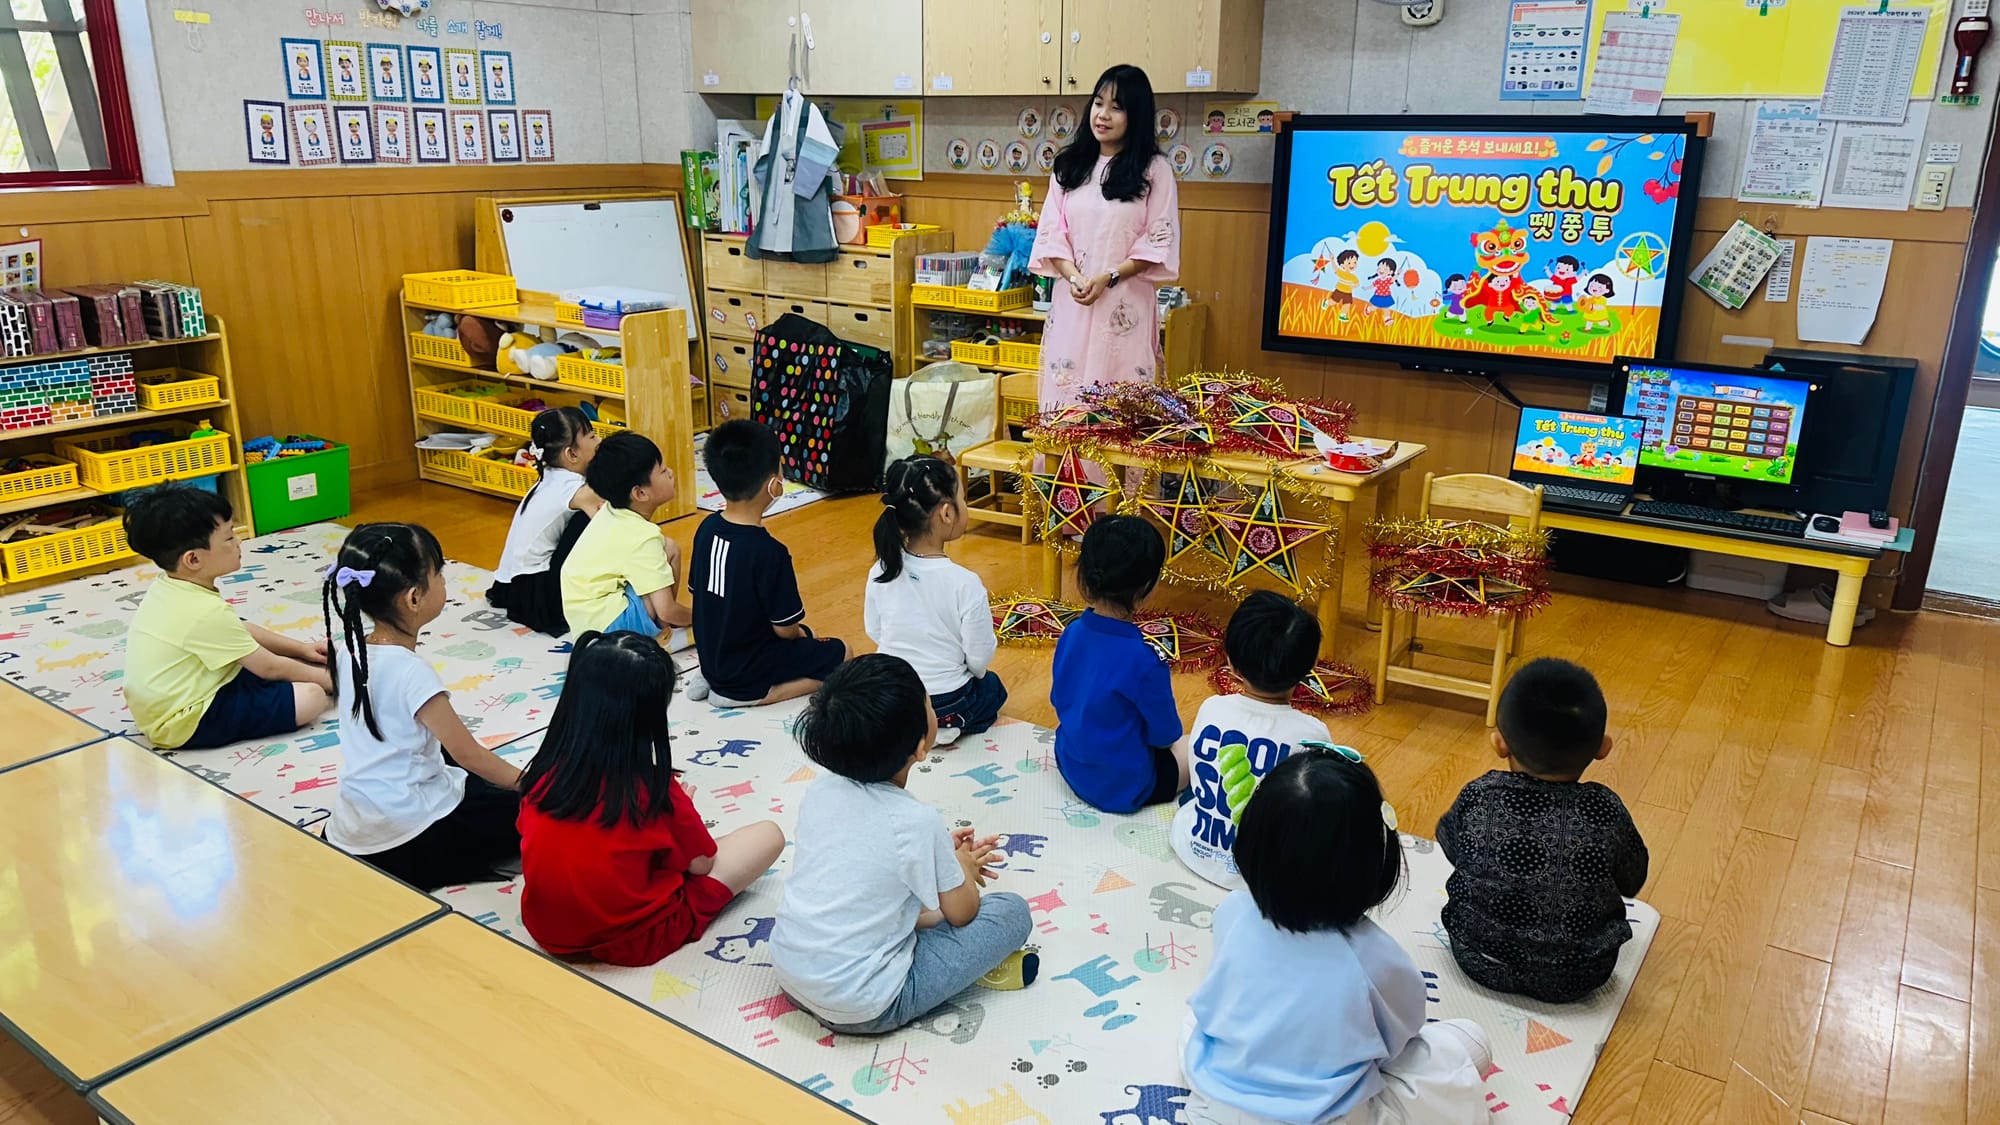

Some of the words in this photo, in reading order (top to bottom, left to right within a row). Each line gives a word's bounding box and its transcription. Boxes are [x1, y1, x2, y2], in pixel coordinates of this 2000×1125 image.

[401, 5, 410, 13] 30
[420, 0, 429, 8] 25
[304, 8, 344, 27] 만나서
[417, 16, 438, 37] 나를
[447, 20, 468, 33] 소개
[475, 20, 502, 40] 할게!
[1227, 117, 1255, 128] 도서관
[1419, 138, 1452, 155] 즐거운
[1456, 139, 1480, 155] 추석
[1483, 139, 1540, 155] 보내세요!
[1328, 160, 1397, 206] Tết
[1404, 163, 1530, 214] Trung
[1535, 165, 1623, 212] thu
[1560, 212, 1583, 242] 쭝
[1589, 214, 1612, 242] 투
[1534, 419, 1557, 432] Tết
[1560, 421, 1598, 438] Trung
[1600, 426, 1626, 440] thu
